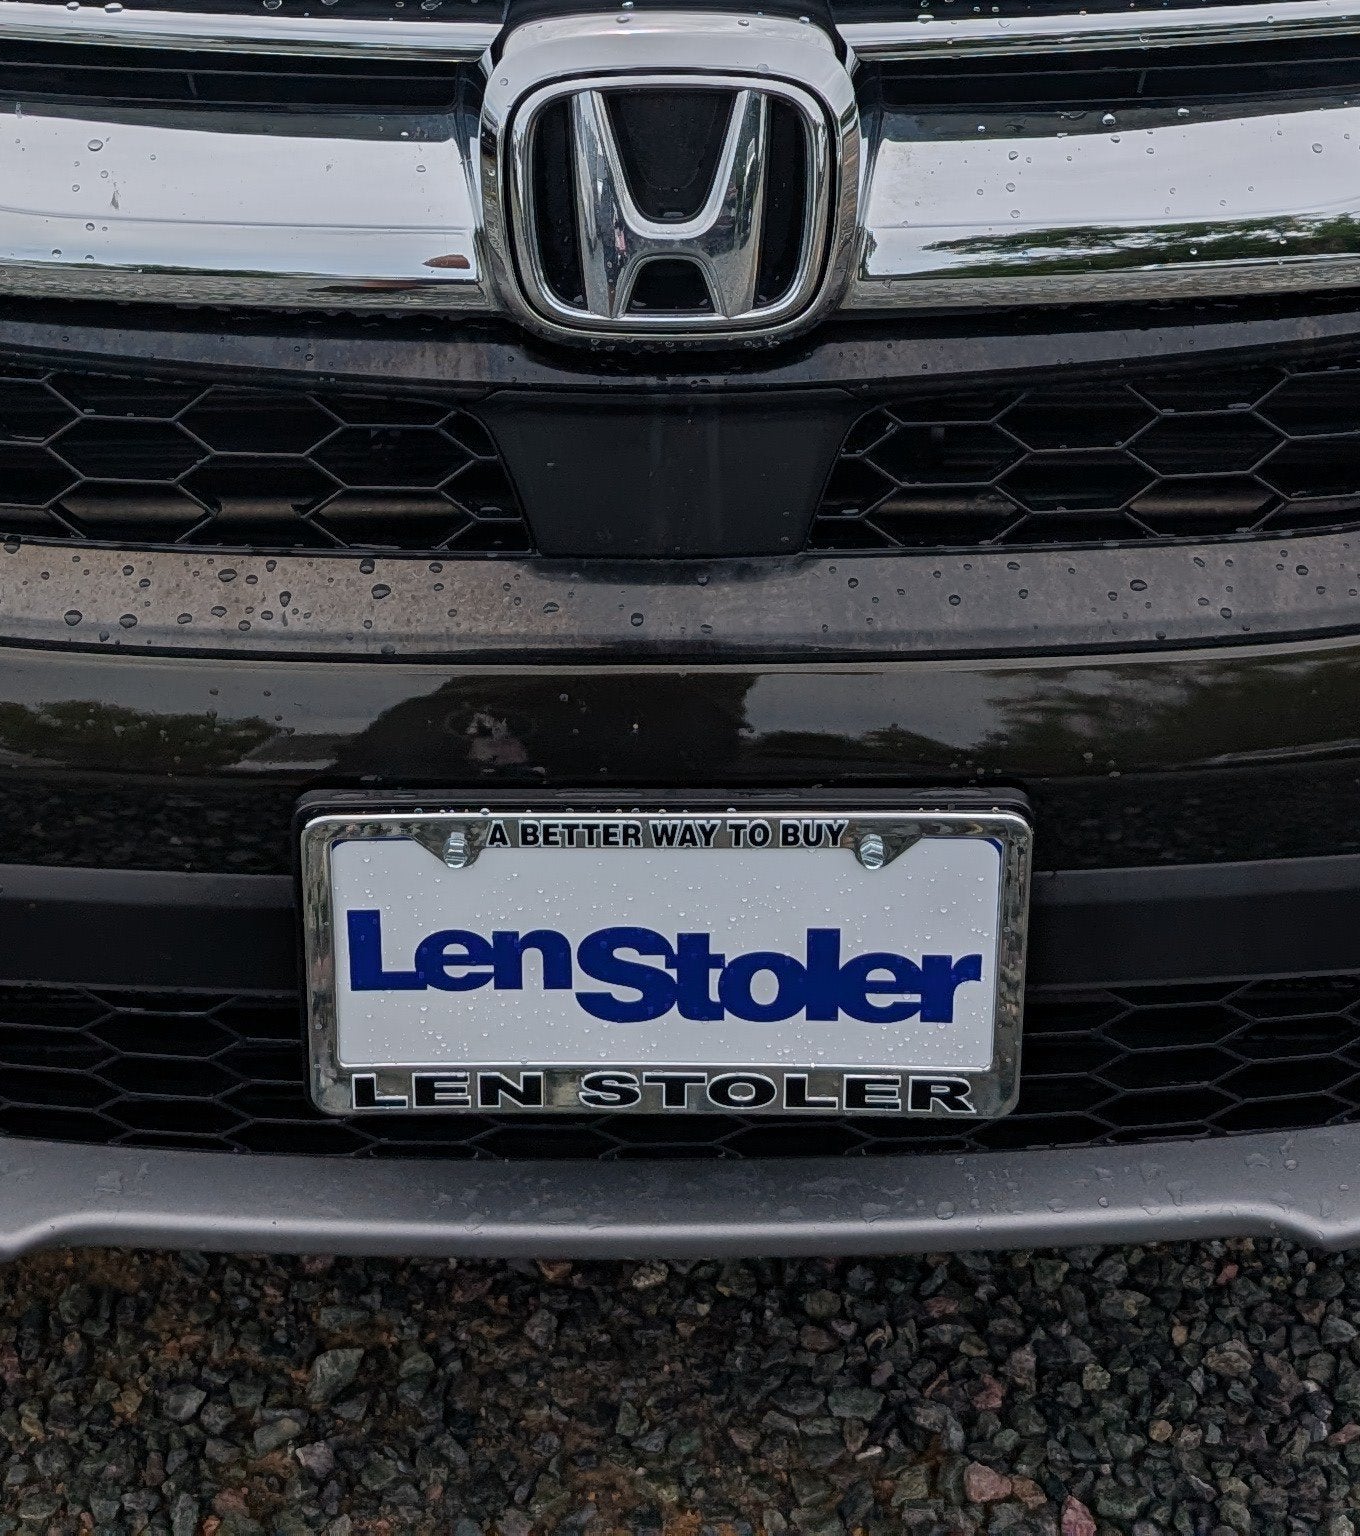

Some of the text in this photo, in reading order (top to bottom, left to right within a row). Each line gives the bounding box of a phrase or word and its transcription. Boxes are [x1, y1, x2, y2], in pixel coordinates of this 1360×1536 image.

[484, 819, 850, 848] A BETTER WAY TO BUY
[350, 1071, 978, 1115] LEN STOLER
